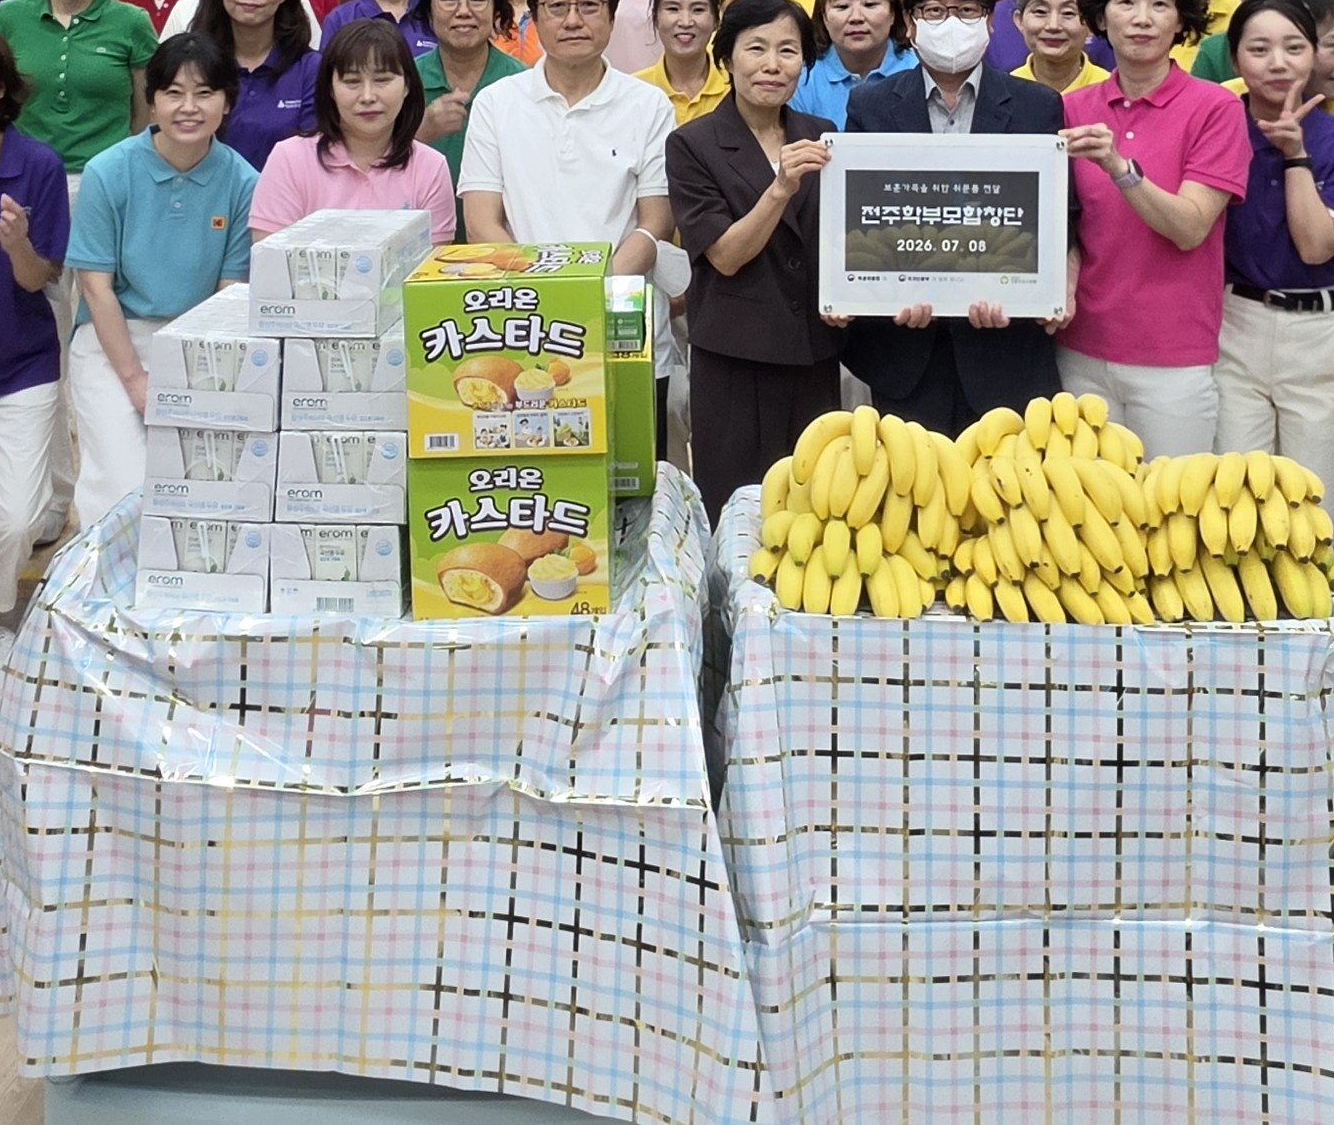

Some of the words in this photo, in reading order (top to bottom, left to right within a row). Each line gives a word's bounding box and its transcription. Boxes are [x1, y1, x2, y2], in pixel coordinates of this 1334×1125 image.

[860, 205, 1025, 227] 전주학부모합창단
[896, 238, 937, 253] 2026.
[941, 239, 965, 253] 07.
[968, 240, 987, 253] 08
[464, 286, 540, 313] 오리온
[260, 304, 296, 315] erom
[419, 313, 586, 362] 카스타드
[157, 391, 192, 404] erom
[292, 396, 328, 408] erom
[468, 466, 544, 493] 오리온
[154, 482, 189, 495] erom
[287, 488, 323, 500] erom
[424, 492, 591, 543] 카스타드
[319, 530, 353, 538] erom
[147, 574, 183, 586] erom
